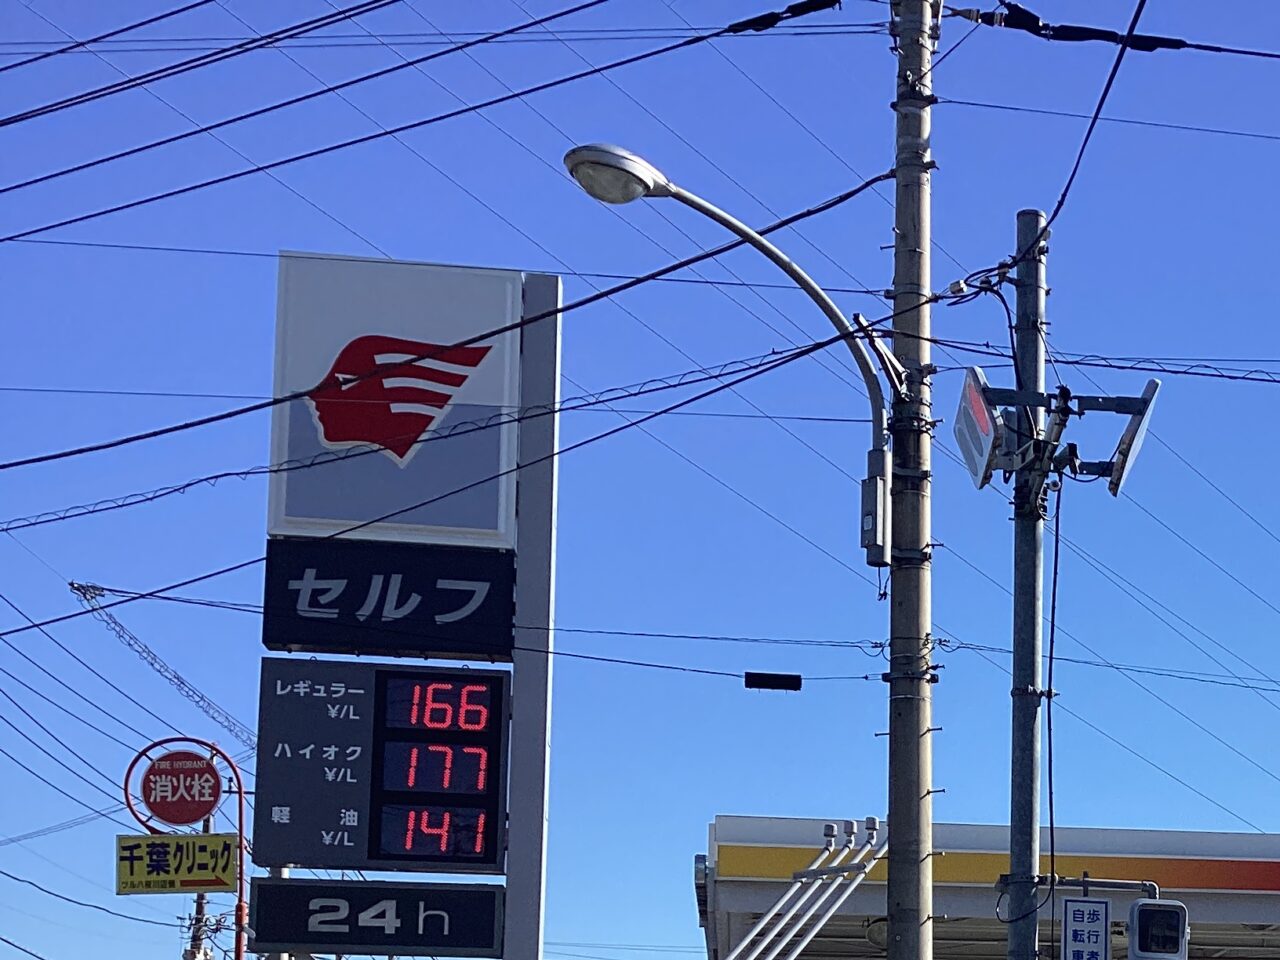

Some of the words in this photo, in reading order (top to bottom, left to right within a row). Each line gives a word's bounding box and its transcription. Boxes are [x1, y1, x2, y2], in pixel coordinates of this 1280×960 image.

[287, 568, 490, 625] セルフ
[275, 680, 366, 698] レギュラー
[409, 683, 488, 732] 166
[154, 760, 171, 770] FIRE
[173, 760, 208, 769] HYDRANT
[273, 743, 363, 762] ハイオク
[407, 745, 488, 791] 177
[149, 773, 215, 803] 消火栓
[405, 809, 486, 853] 141
[119, 840, 232, 877] 千葉クリニック
